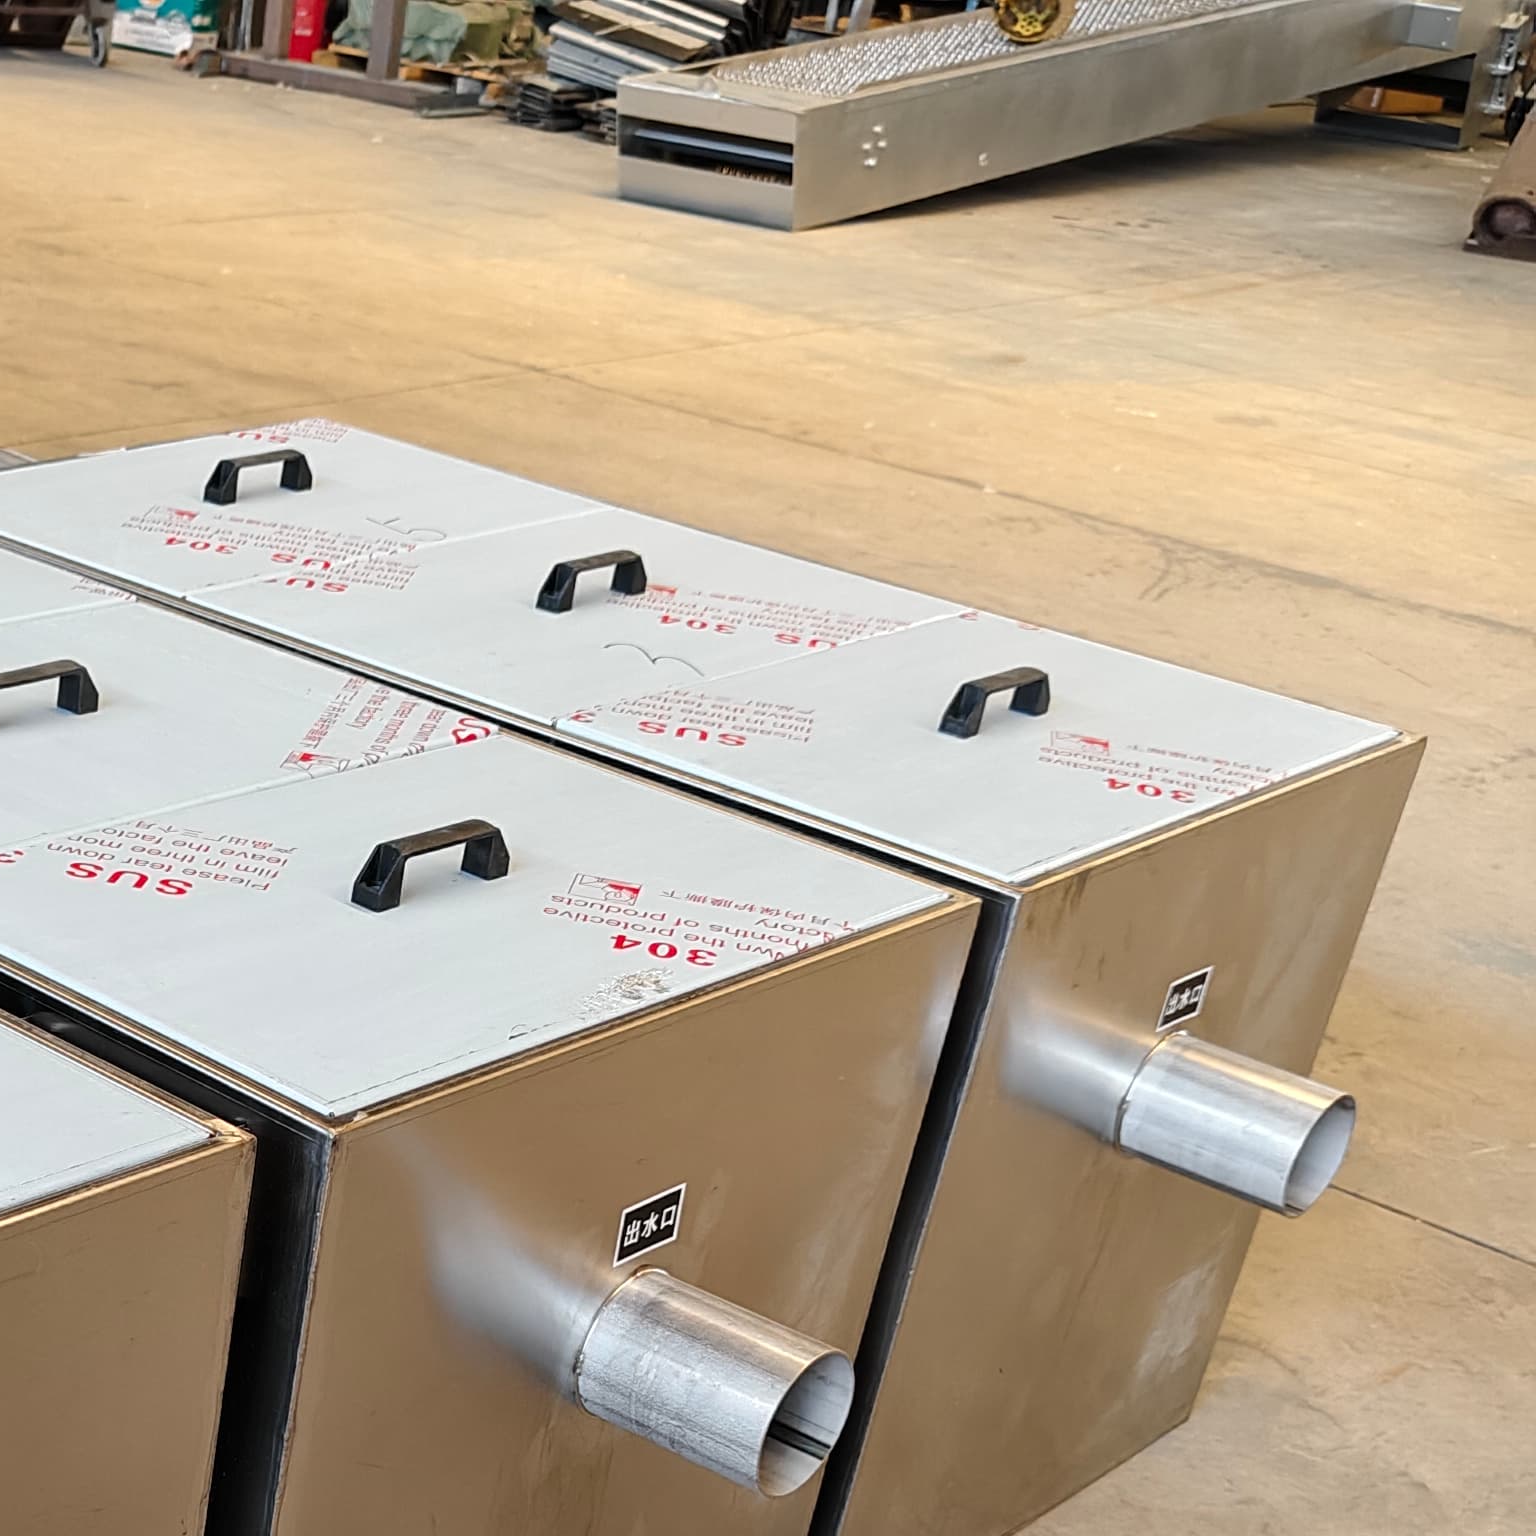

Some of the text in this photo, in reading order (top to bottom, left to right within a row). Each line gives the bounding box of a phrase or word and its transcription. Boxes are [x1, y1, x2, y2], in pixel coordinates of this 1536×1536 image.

[165, 537, 239, 555] 304
[660, 615, 737, 635] 304
[637, 719, 749, 748] SUS
[1103, 778, 1196, 804] 304
[47, 842, 114, 863] down
[119, 855, 175, 875] tear
[130, 844, 197, 866] three
[171, 838, 290, 869] leave the
[203, 856, 227, 869] in
[64, 861, 194, 897] SUS
[181, 866, 272, 892] Please
[233, 862, 280, 881] film
[551, 894, 667, 924] products
[543, 905, 733, 951] the protective
[673, 916, 701, 930] of
[610, 933, 719, 969] 304
[1164, 983, 1204, 1017] 出水口
[623, 1204, 678, 1248] 出水口
